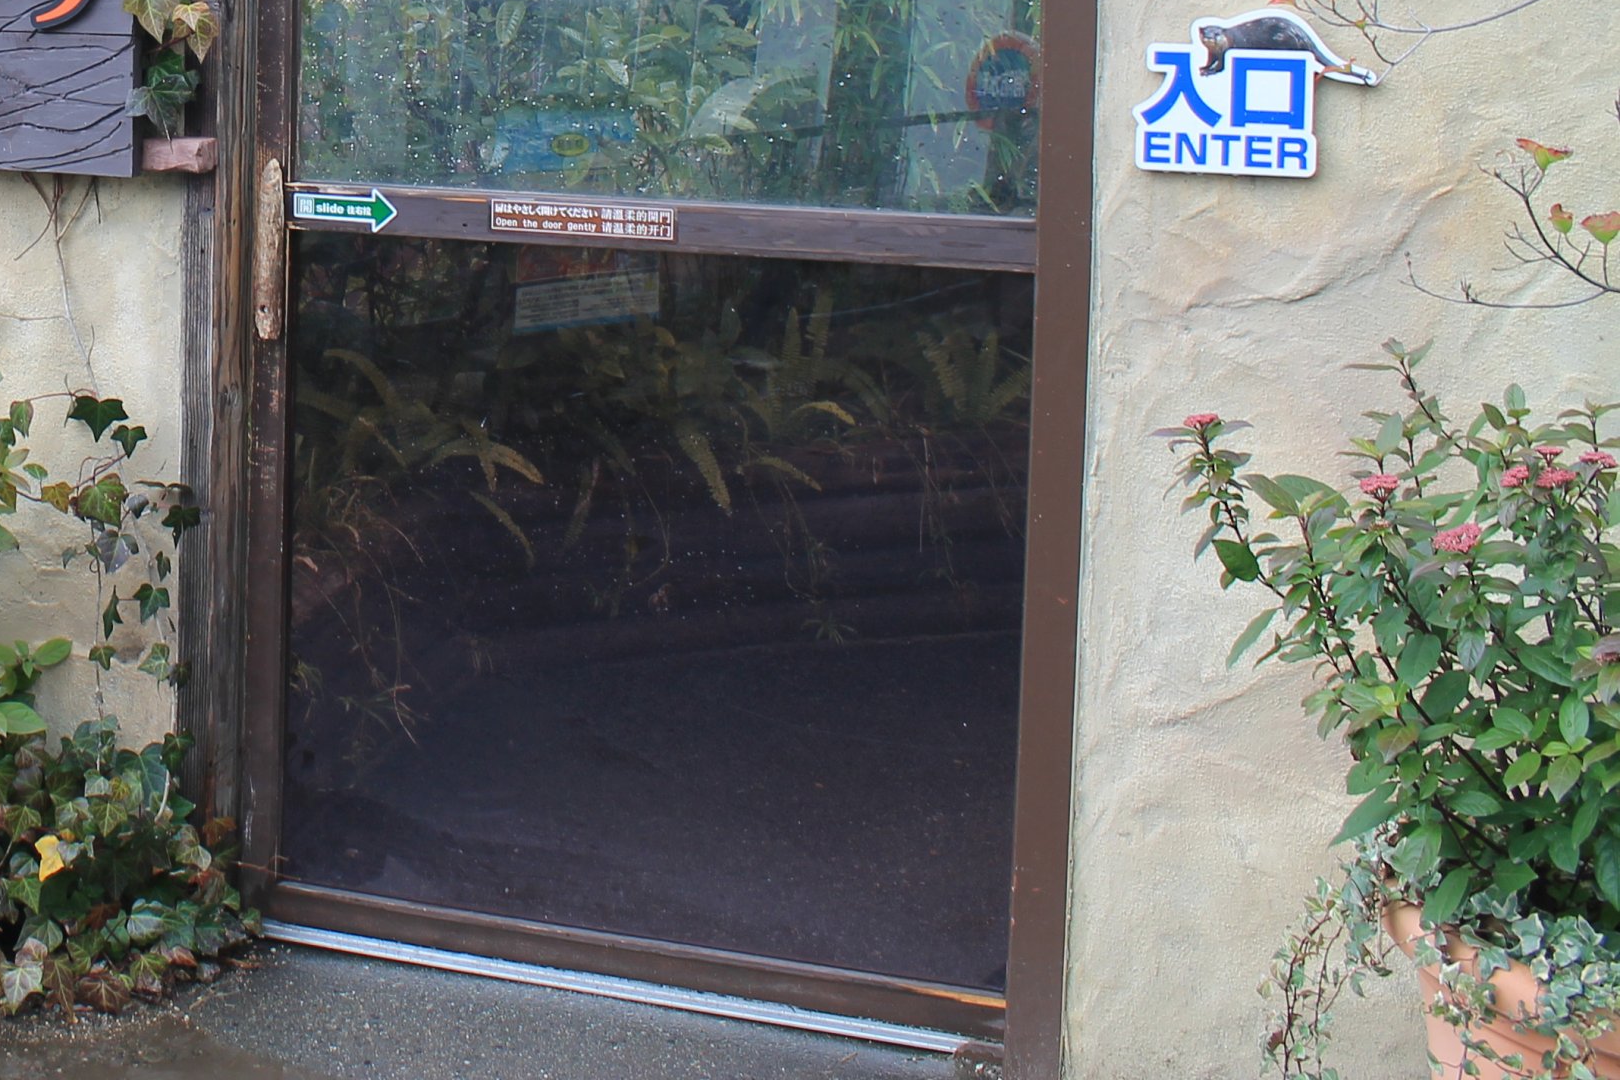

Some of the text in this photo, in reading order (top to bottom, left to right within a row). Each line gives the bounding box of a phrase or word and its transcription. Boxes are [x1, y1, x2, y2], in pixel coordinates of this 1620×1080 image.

[1141, 51, 1307, 130] 入口
[1143, 131, 1309, 170] ENTER
[316, 202, 345, 215] slide
[495, 216, 518, 227] Open
[522, 218, 538, 228] the
[542, 219, 563, 229] door
[567, 222, 597, 233] gently
